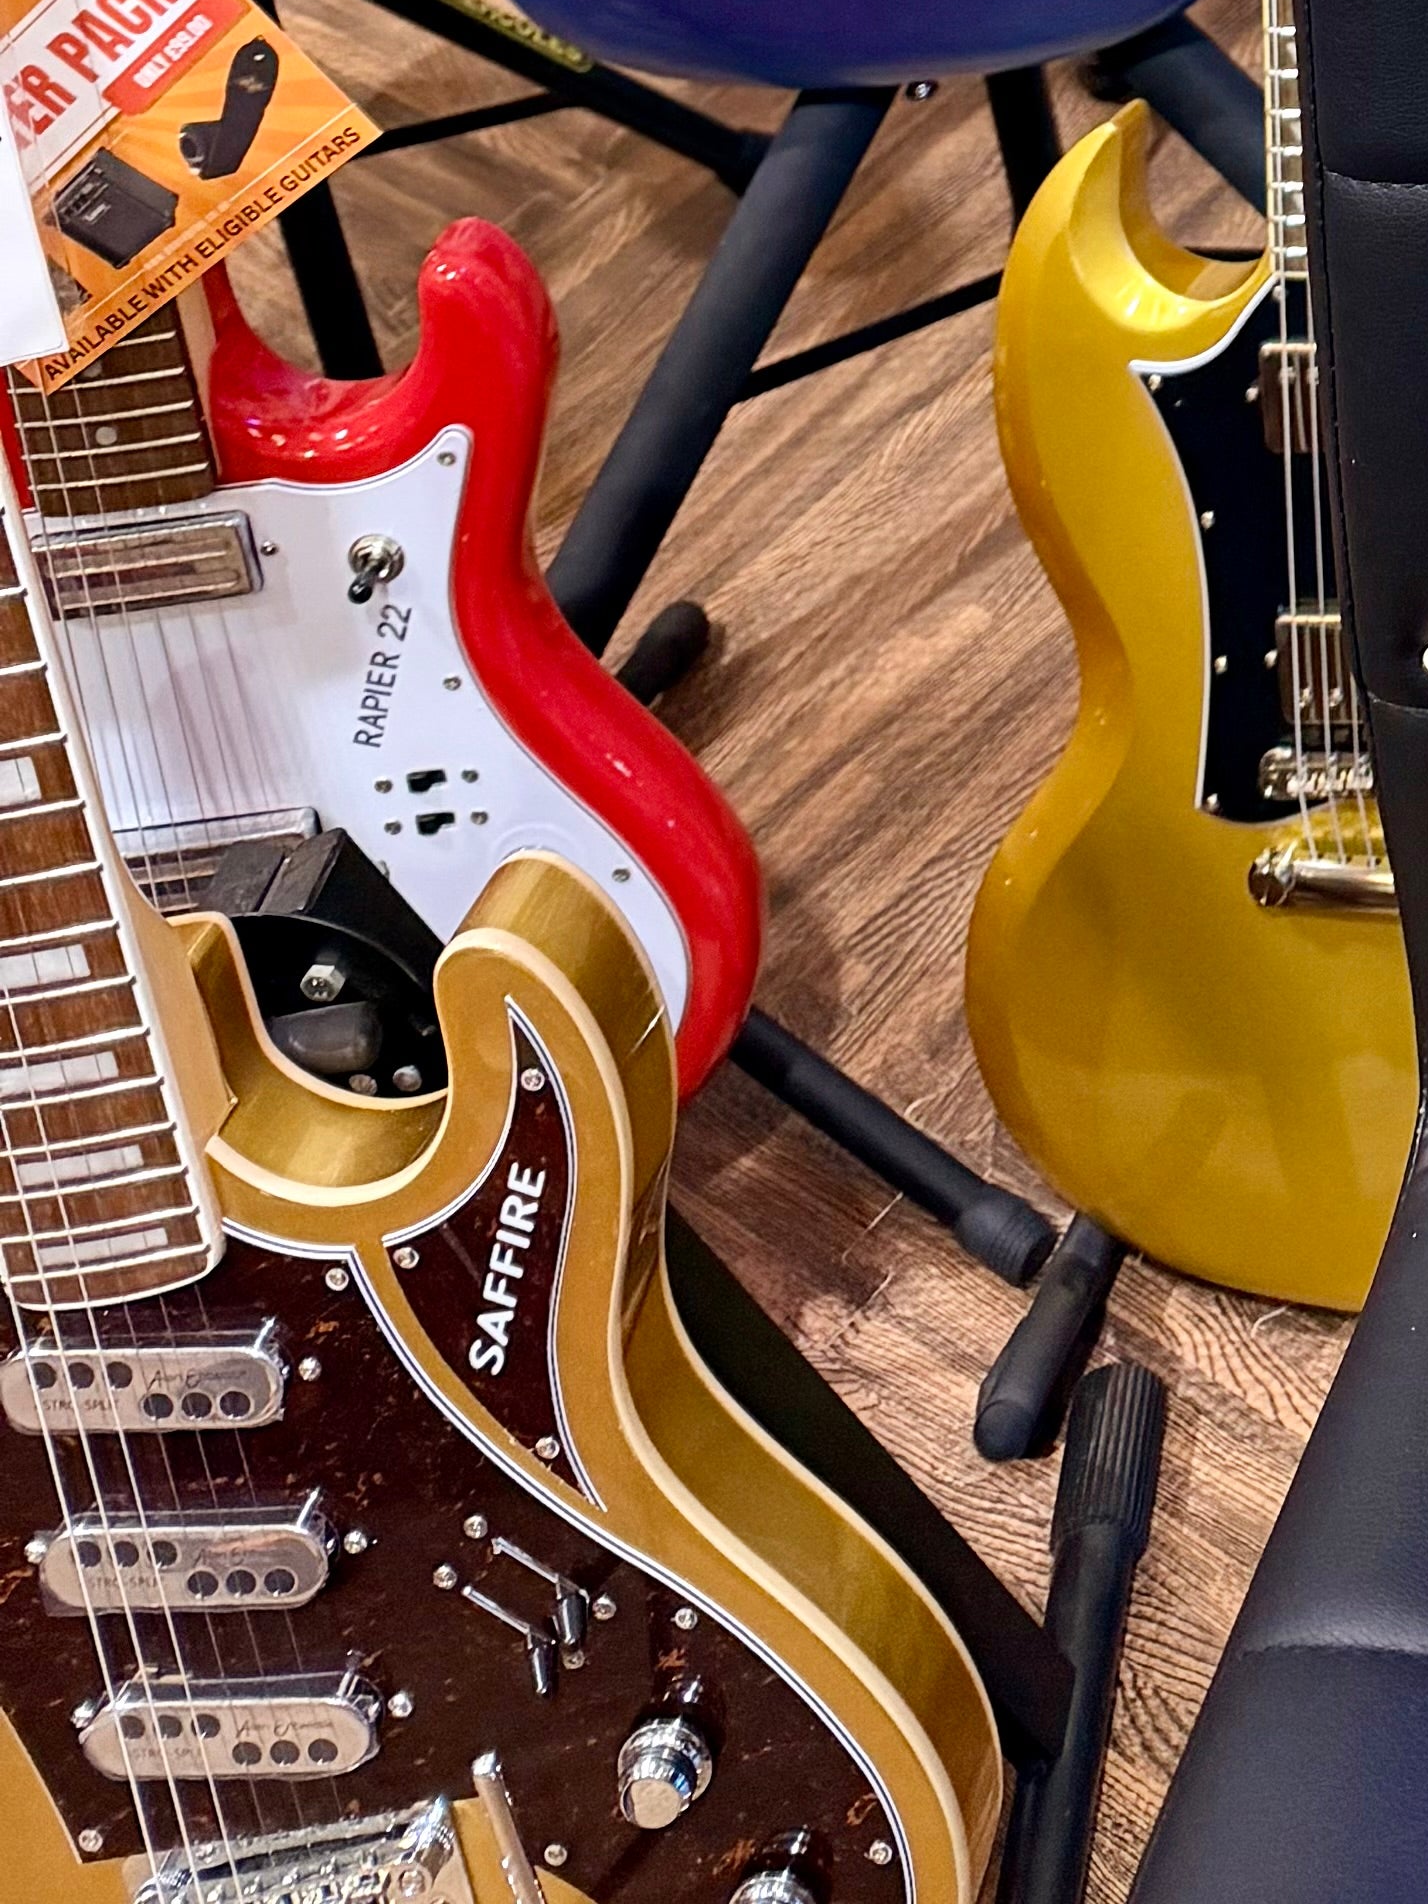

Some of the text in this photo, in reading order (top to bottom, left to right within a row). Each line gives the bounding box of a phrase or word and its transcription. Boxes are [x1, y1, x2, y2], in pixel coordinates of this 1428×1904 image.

[43, 294, 148, 381] AVAILABLE
[142, 253, 199, 299] WITH
[193, 185, 283, 259] ELIGIBLE
[280, 125, 361, 193] GUITARS
[353, 602, 413, 749] RAPIER 22
[469, 1162, 546, 1377] SAFFIRE
